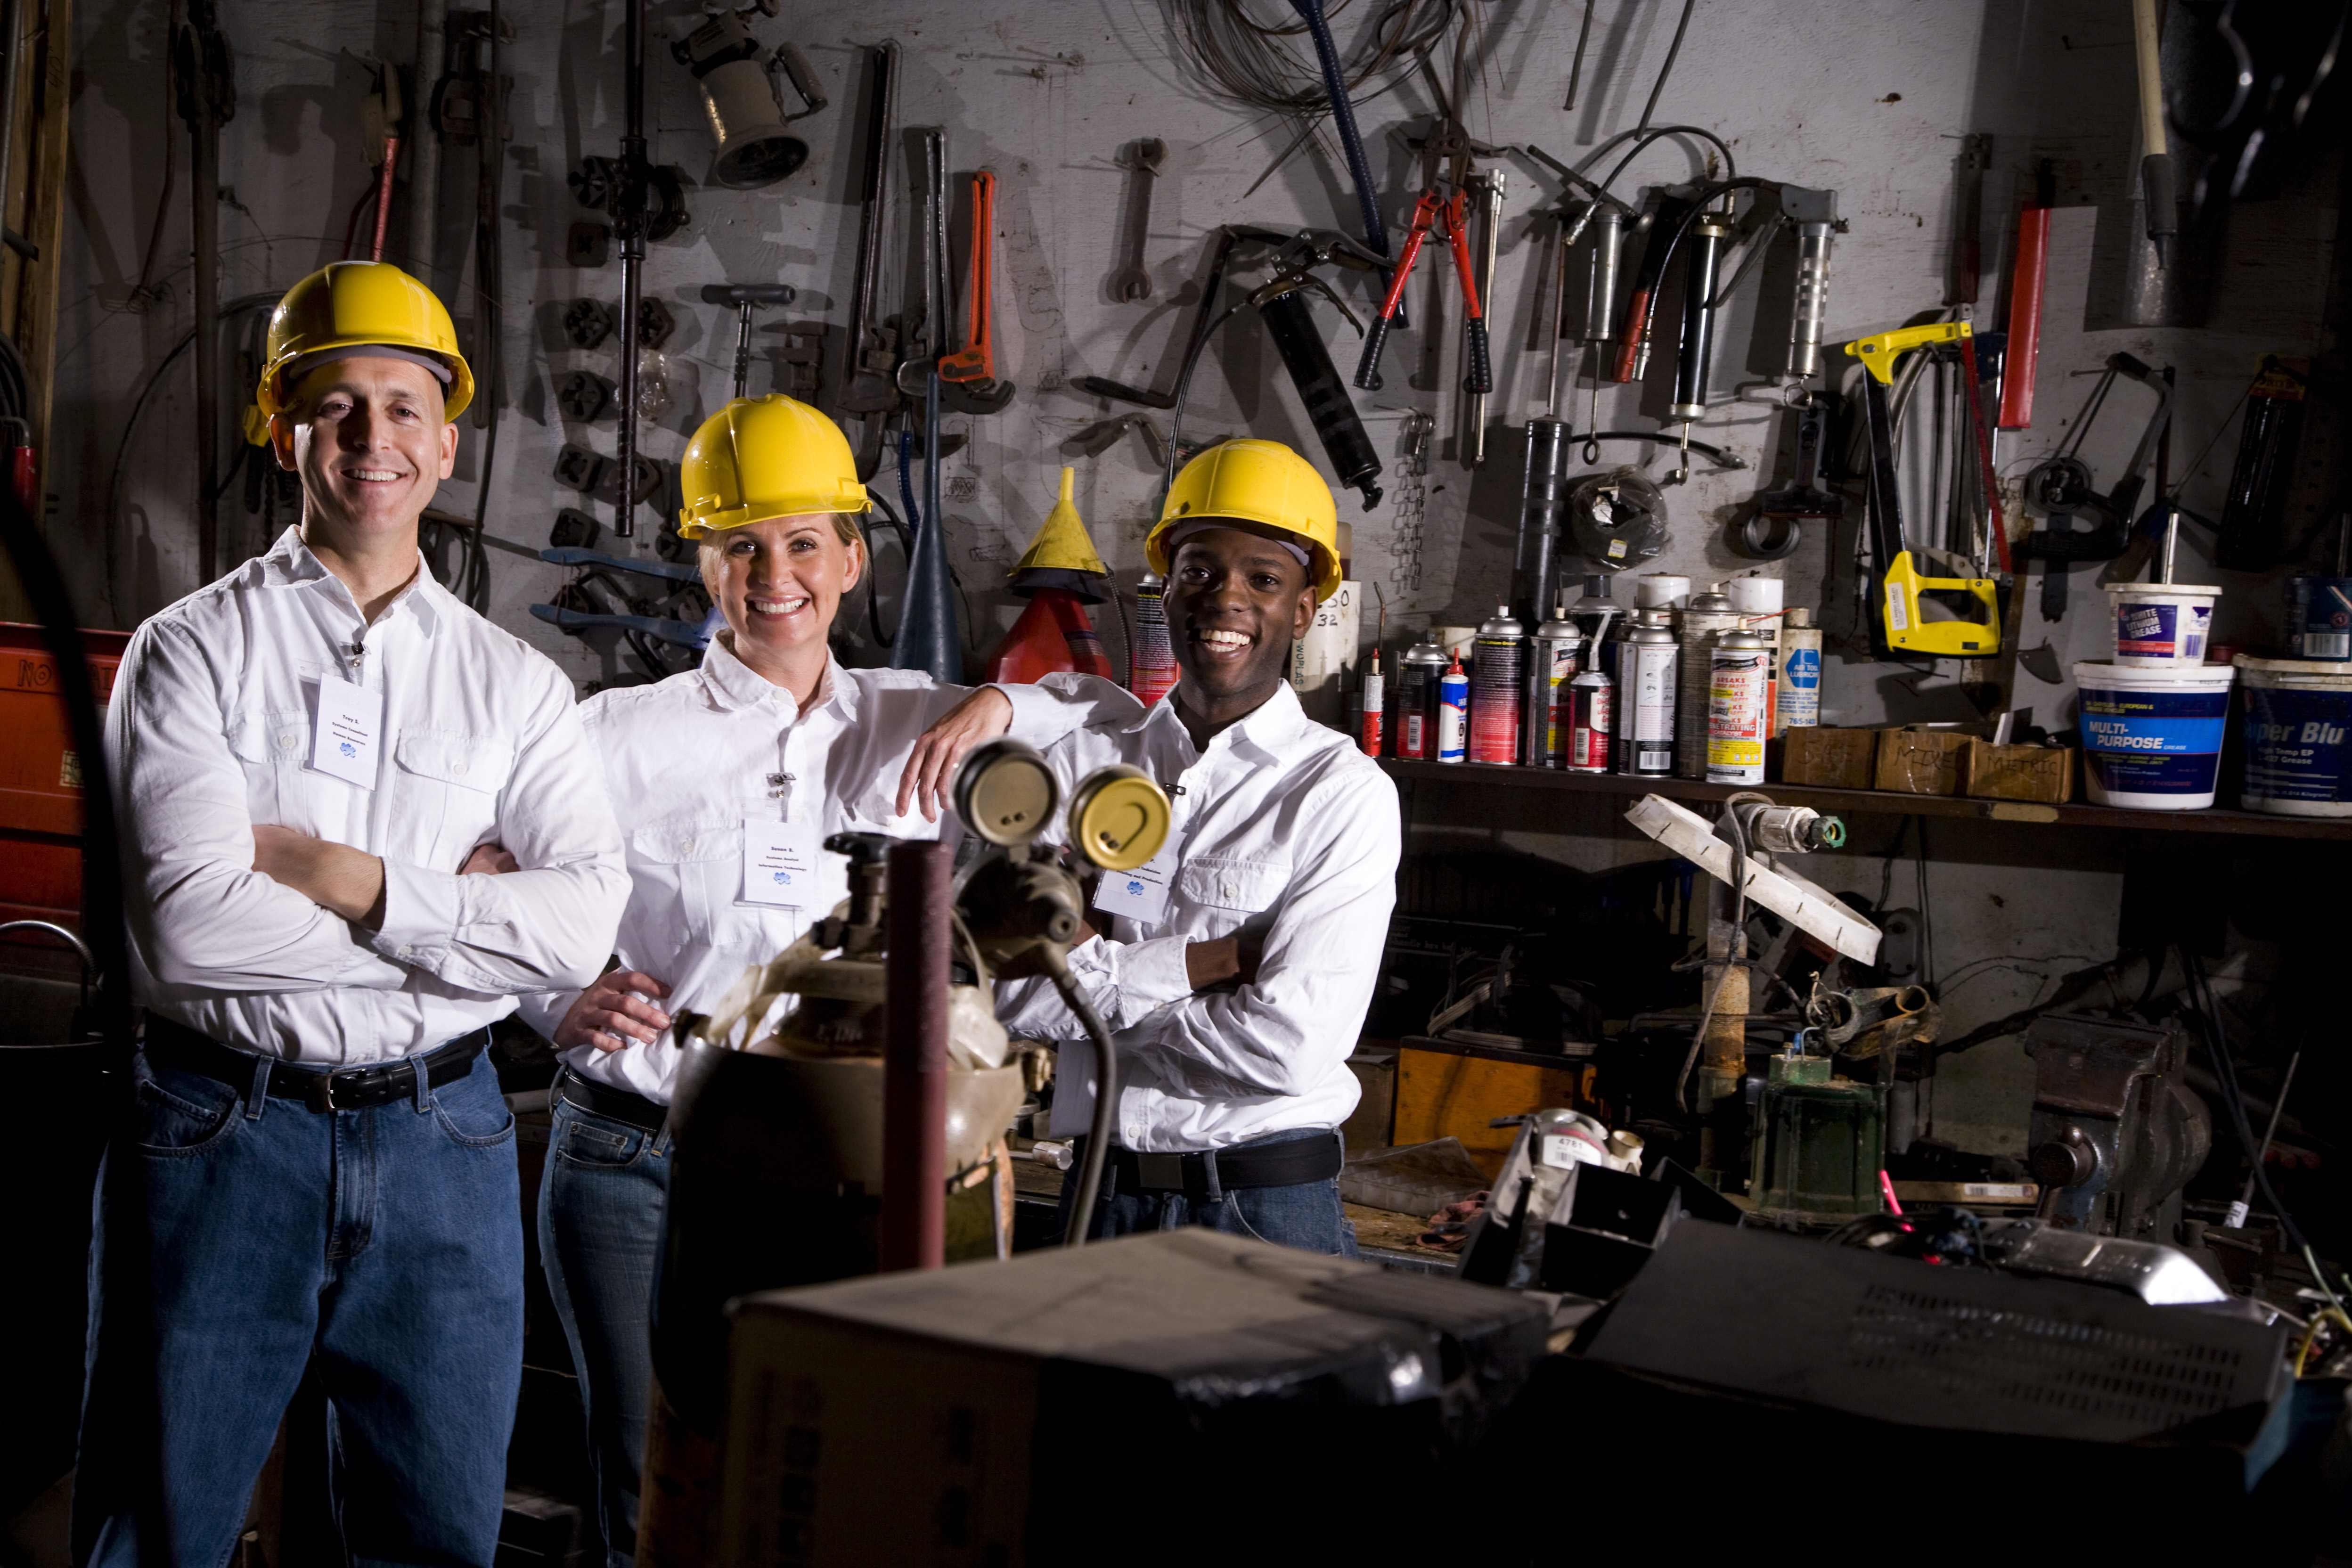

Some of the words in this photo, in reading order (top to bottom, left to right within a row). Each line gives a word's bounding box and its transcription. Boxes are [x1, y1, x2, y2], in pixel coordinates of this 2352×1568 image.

[1317, 614, 1338, 627] 32
[343, 714, 353, 723] Troy
[2089, 721, 2129, 735] MULTI-
[2245, 722, 2295, 743] uper
[2299, 721, 2345, 744] Blu
[2096, 735, 2164, 750] PURPOSE
[1987, 754, 2058, 776] METRIC
